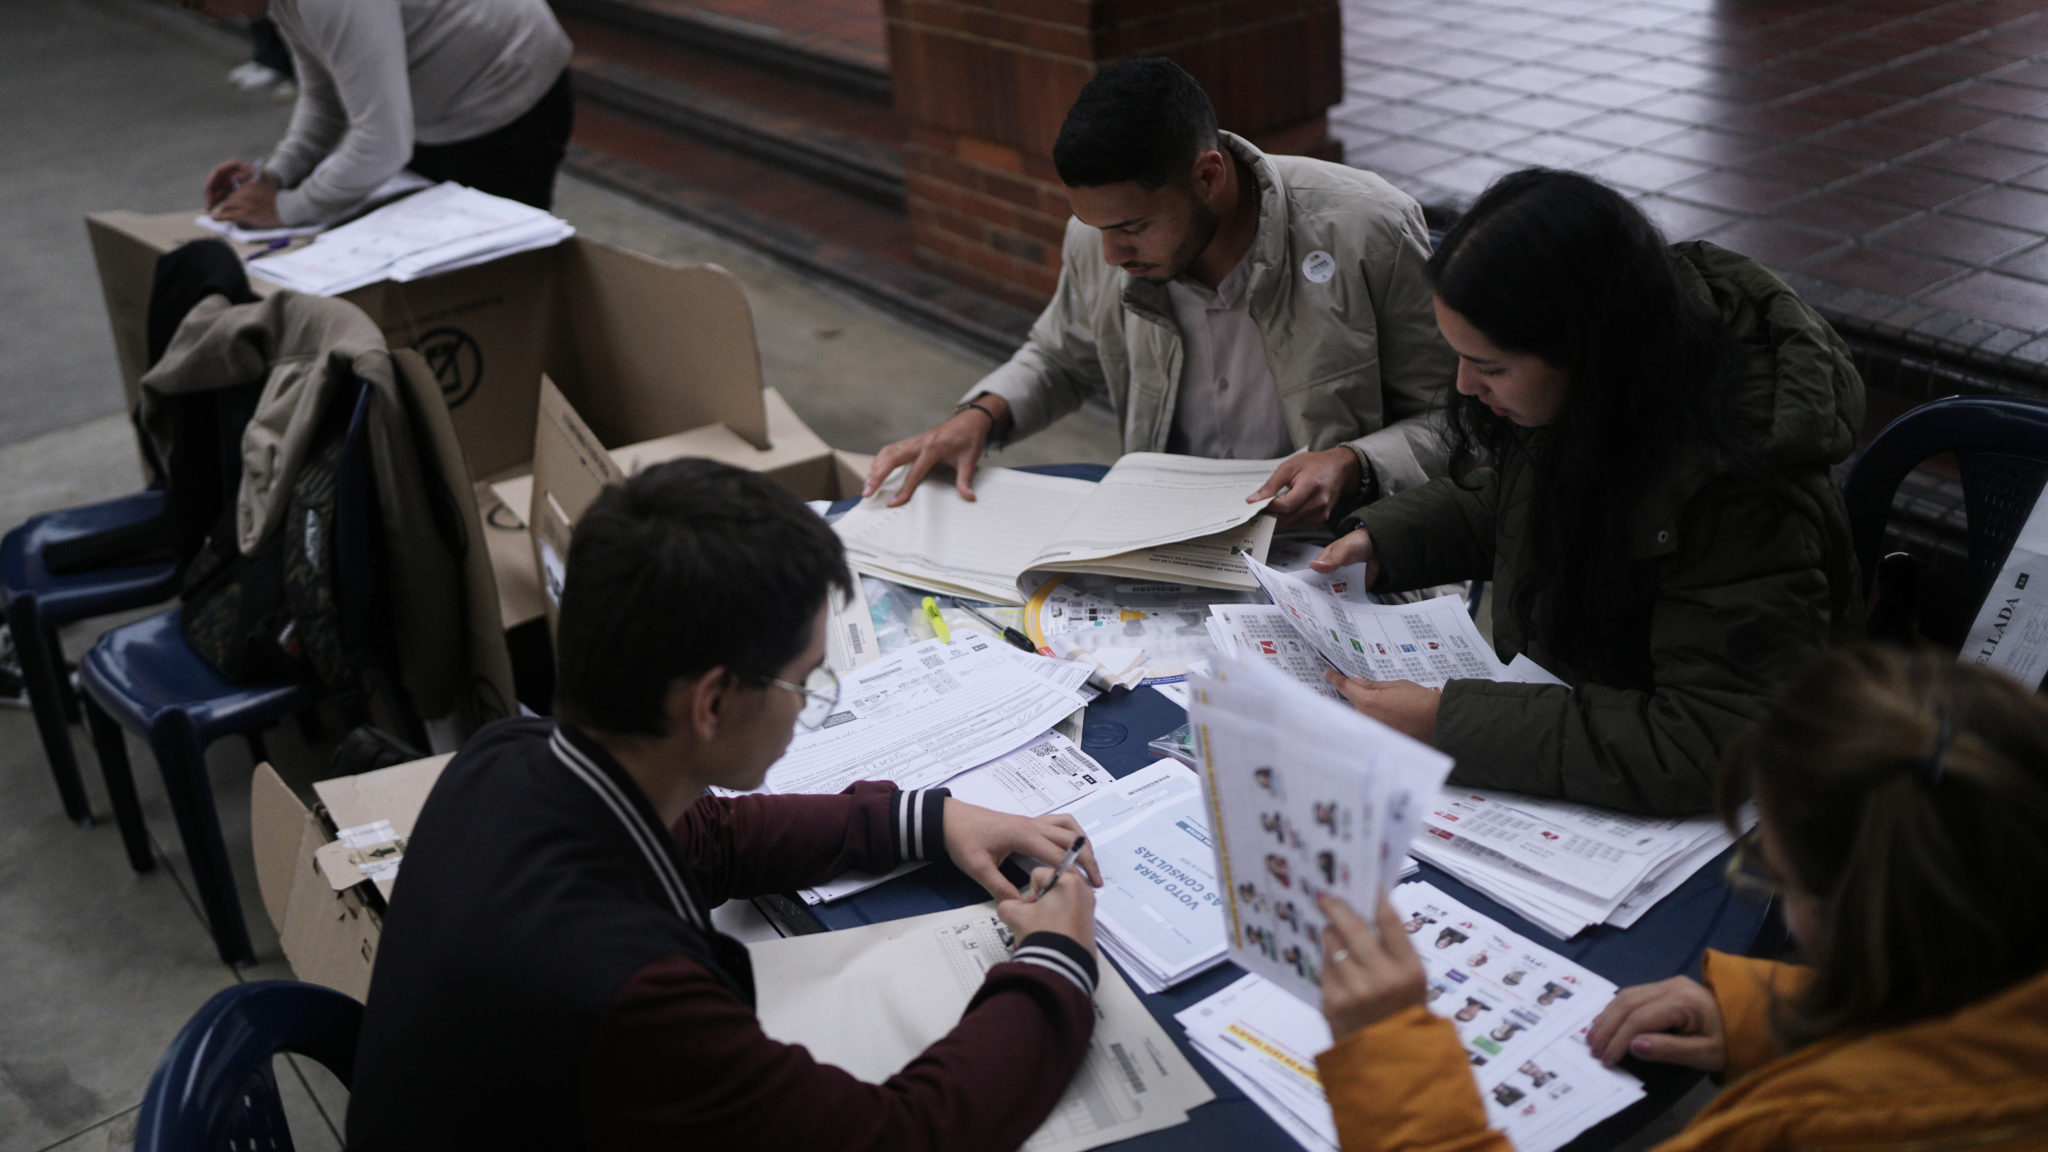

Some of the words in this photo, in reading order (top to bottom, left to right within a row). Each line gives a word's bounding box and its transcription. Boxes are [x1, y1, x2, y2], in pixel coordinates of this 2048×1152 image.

[1134, 846, 1206, 894] CONSULTAS
[1134, 863, 1168, 886] PARA
[1165, 882, 1199, 910] VOTO
